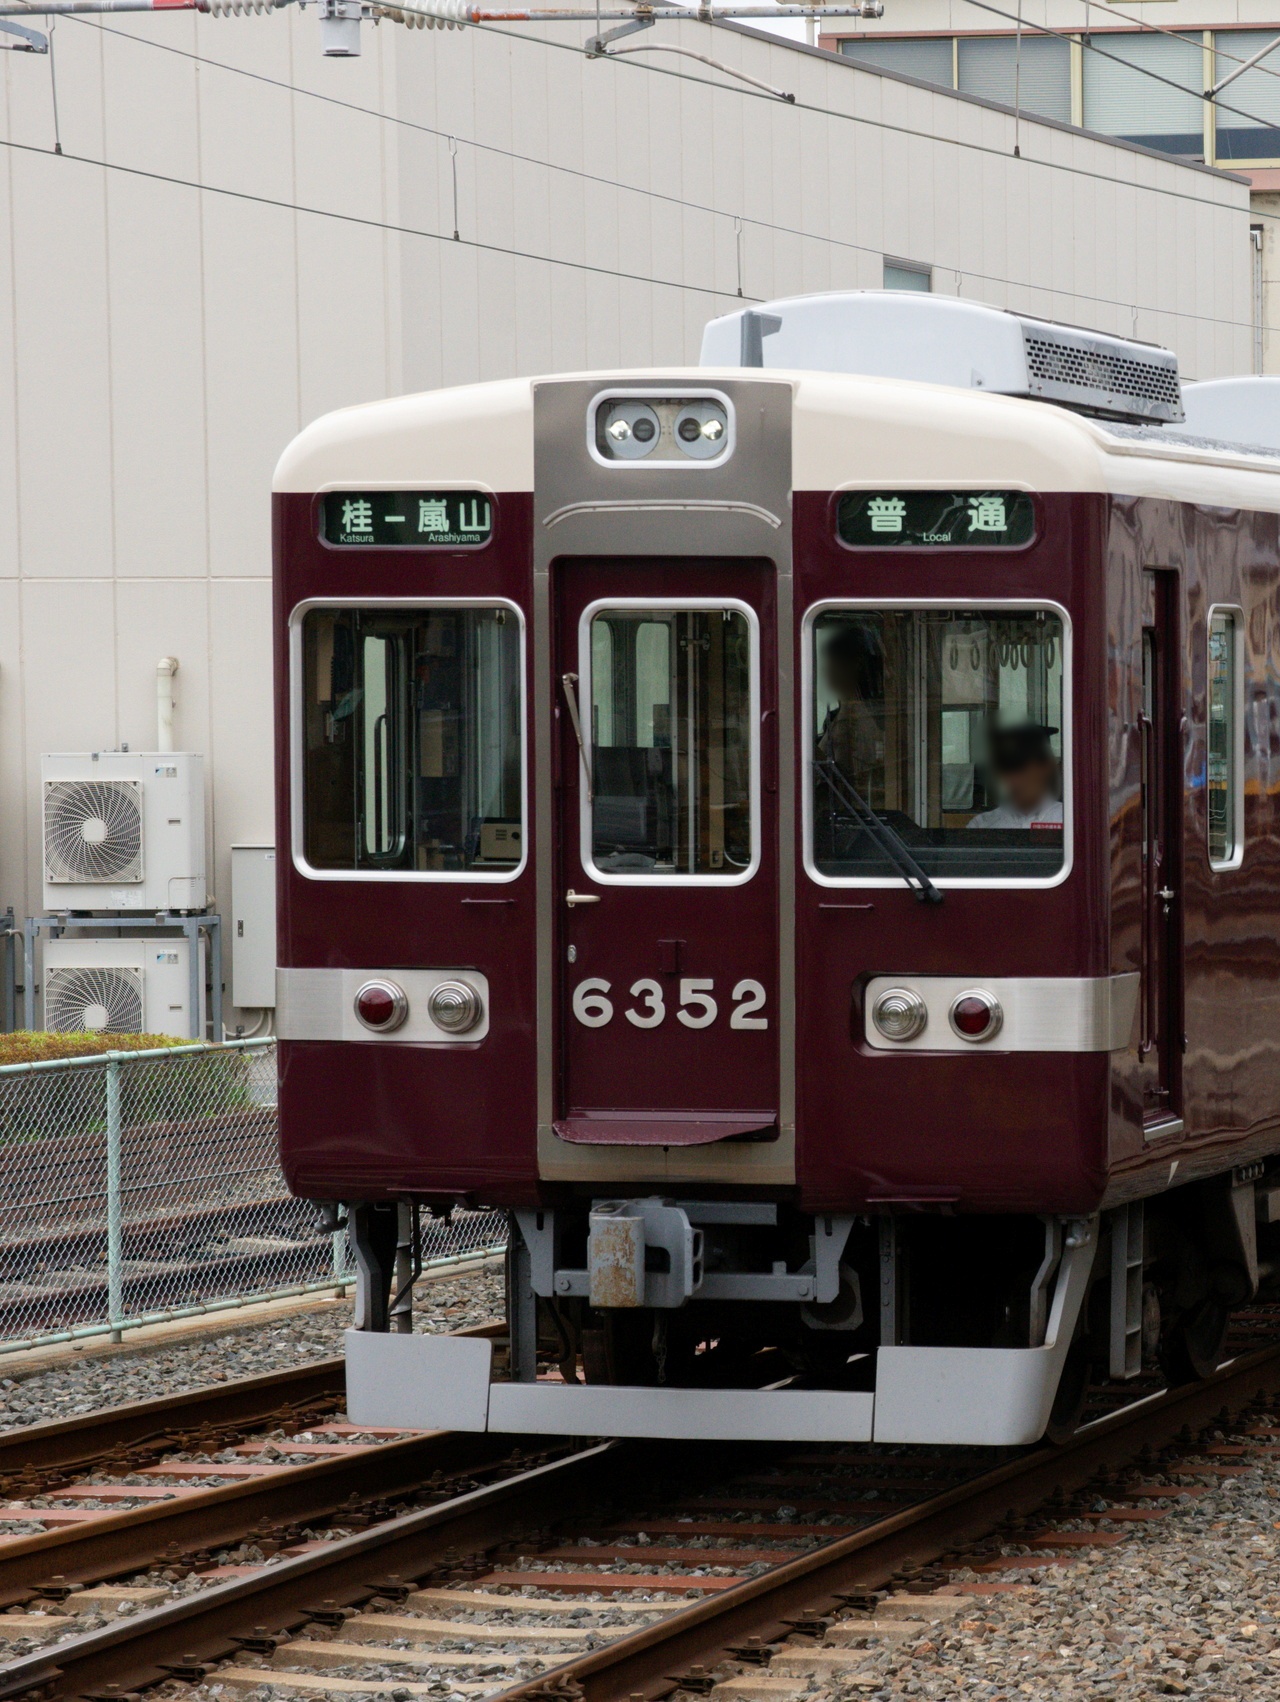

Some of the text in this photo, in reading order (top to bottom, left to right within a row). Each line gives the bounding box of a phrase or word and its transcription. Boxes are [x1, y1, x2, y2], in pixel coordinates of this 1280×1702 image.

[867, 497, 1007, 532] 普通
[340, 533, 375, 542] Katsura
[428, 533, 480, 543] Arashiyama
[923, 532, 951, 542] Local
[572, 977, 768, 1030] 6352
